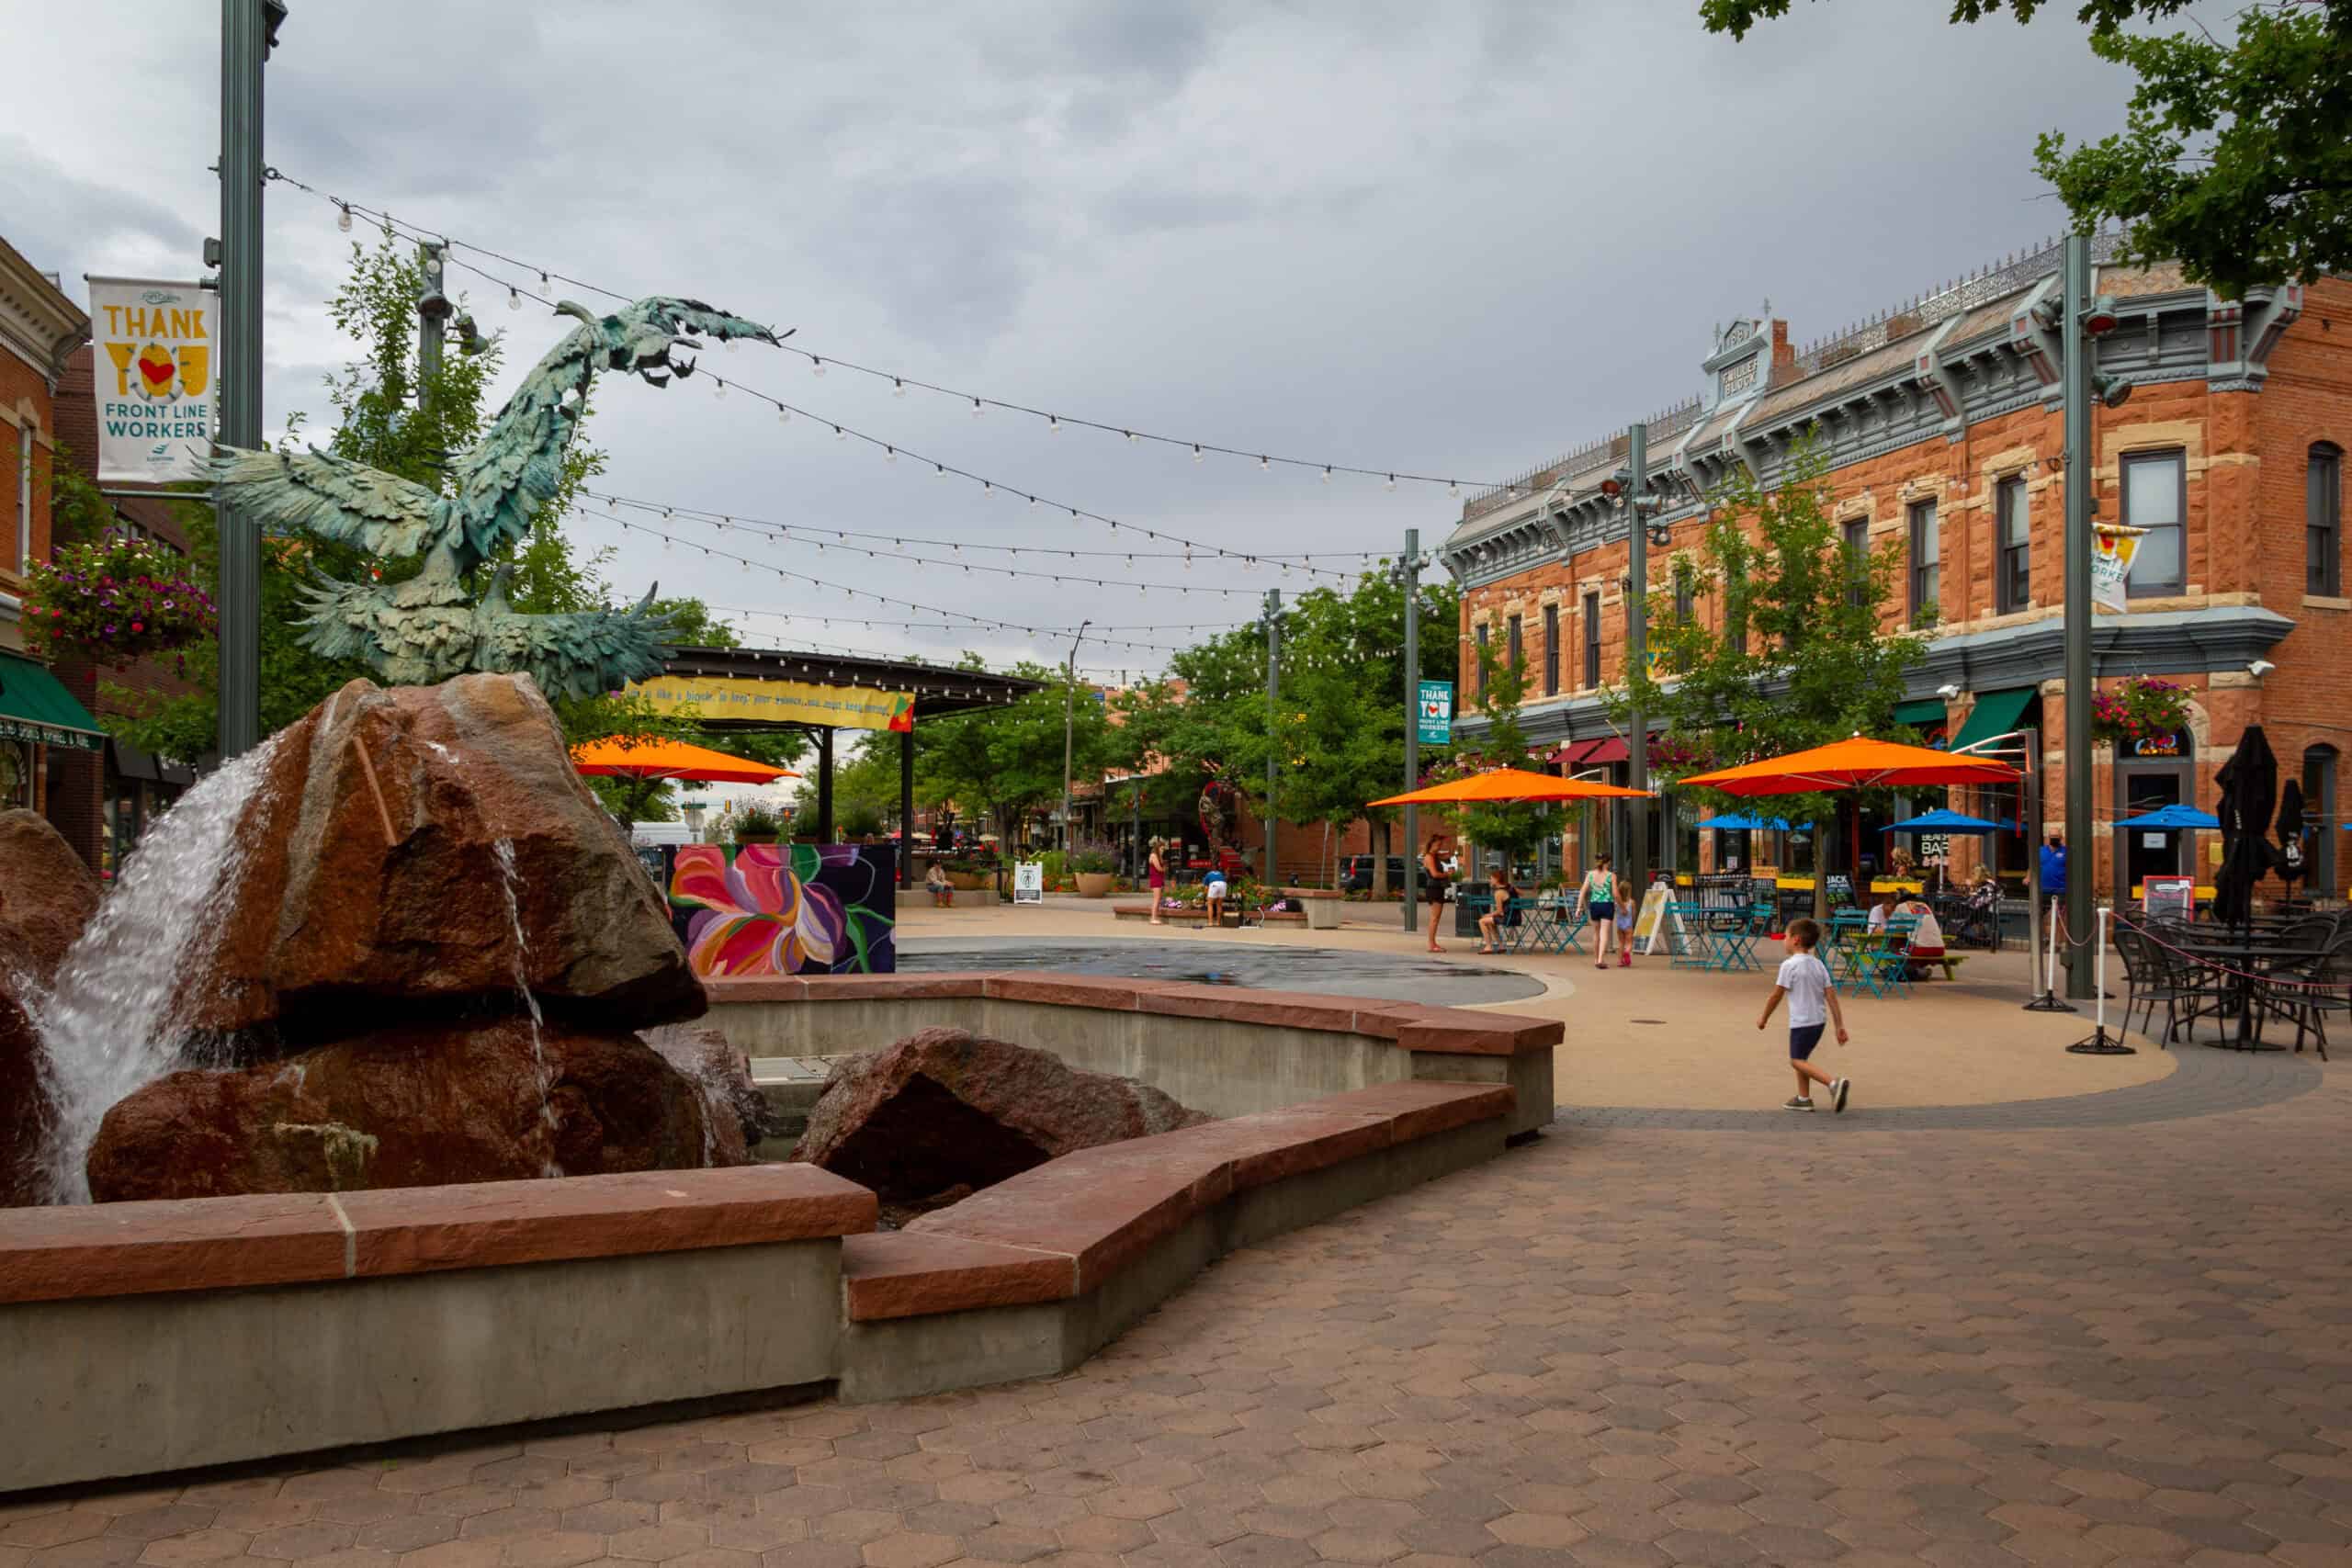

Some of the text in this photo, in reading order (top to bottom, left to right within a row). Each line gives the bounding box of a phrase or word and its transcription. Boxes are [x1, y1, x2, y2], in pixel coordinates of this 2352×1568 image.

[103, 305, 208, 338] THANK
[104, 343, 209, 397] YOU
[1724, 370, 1757, 397] BLOCK
[106, 403, 207, 419] FRONT LINE
[107, 422, 207, 439] WORKERS
[1420, 690, 1449, 700] THANK
[1420, 701, 1449, 718] YOU
[1826, 875, 1848, 884] JACK
